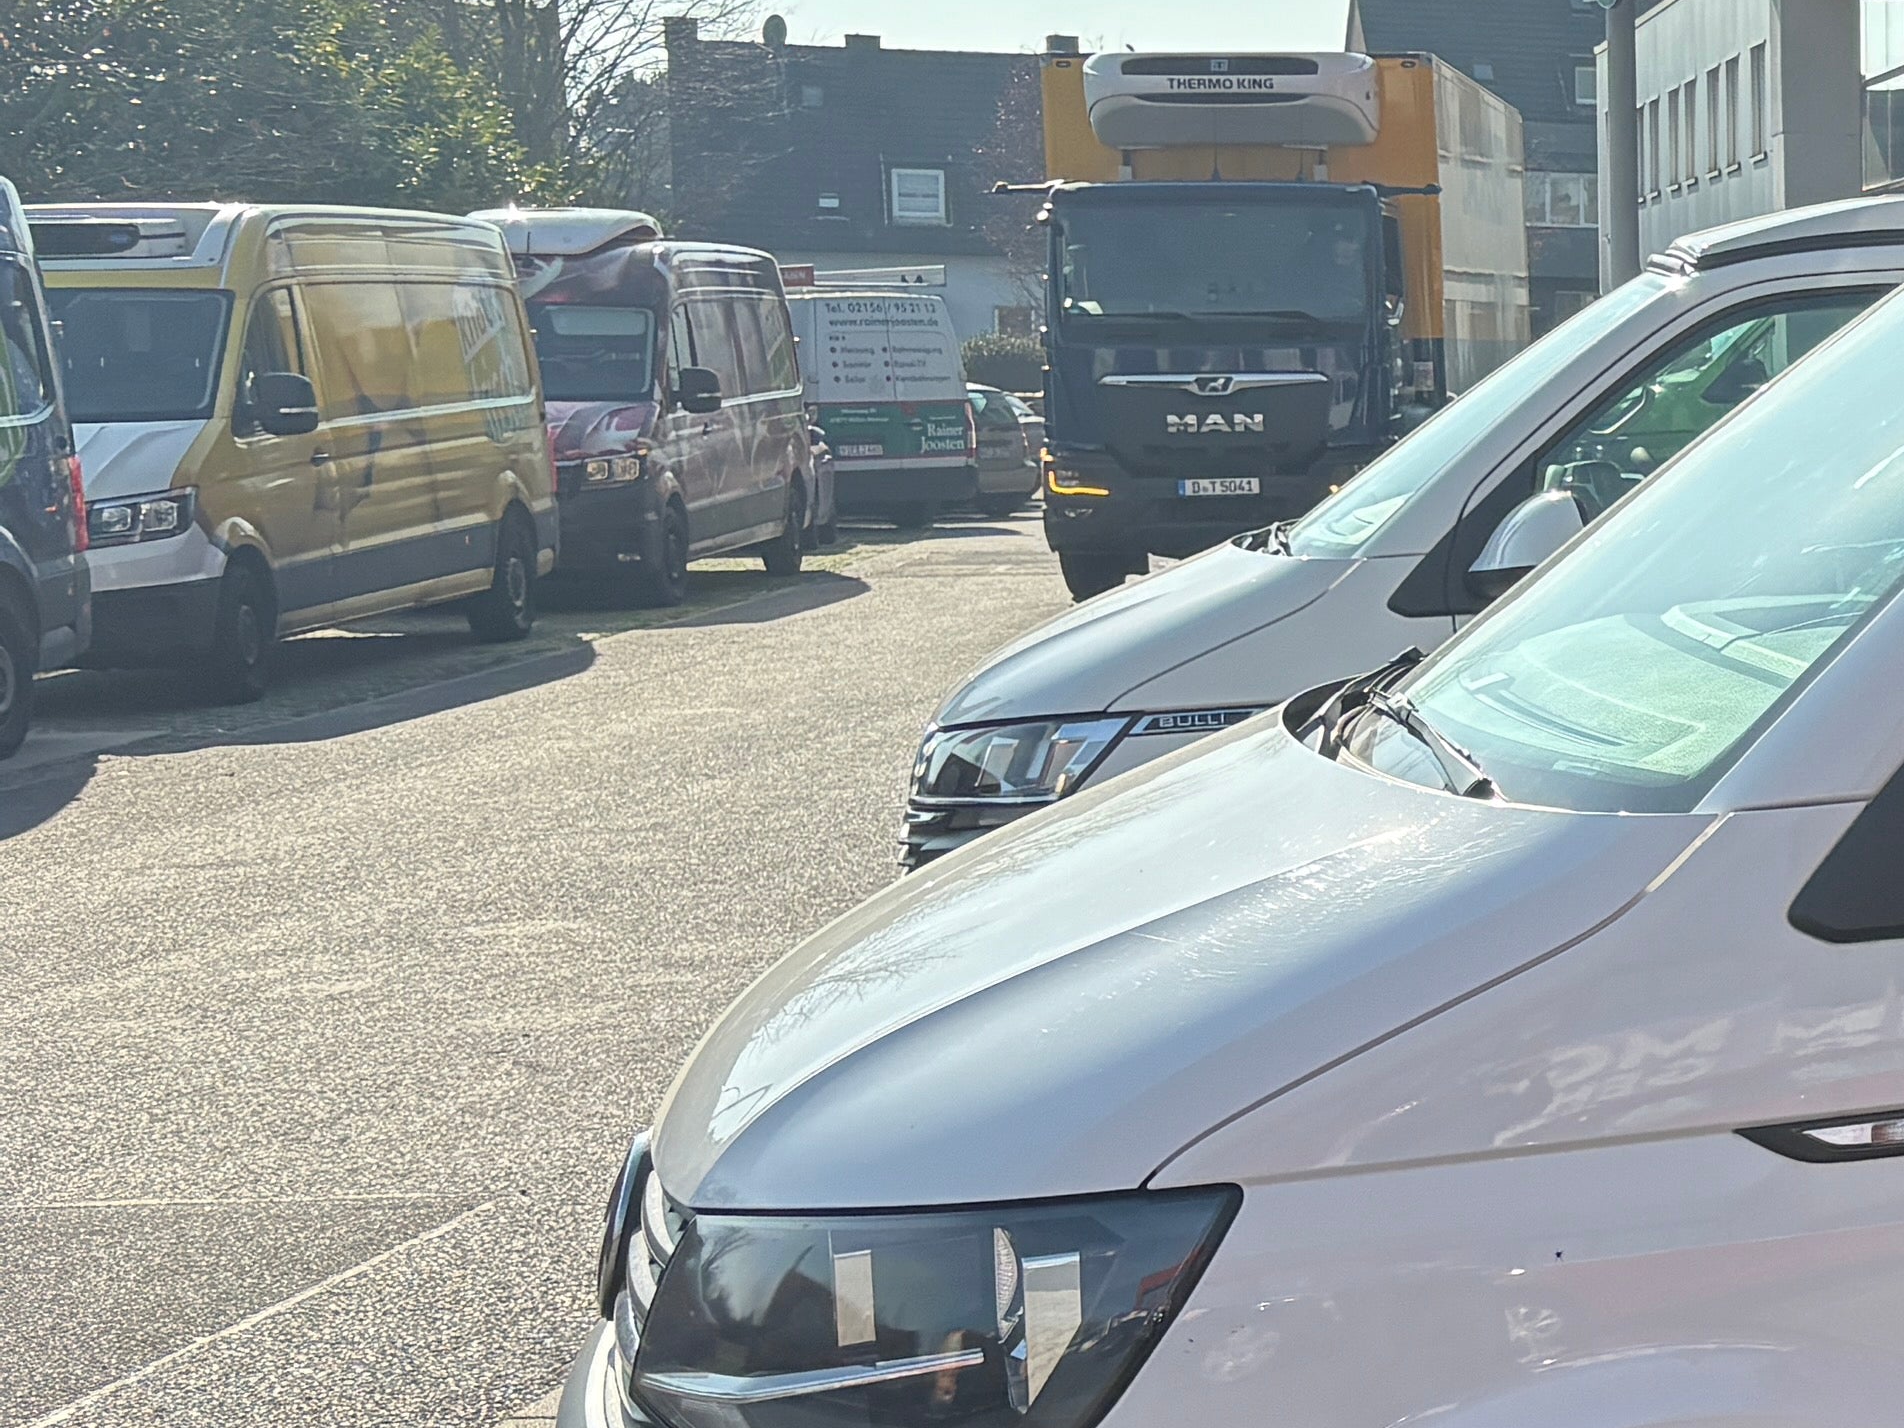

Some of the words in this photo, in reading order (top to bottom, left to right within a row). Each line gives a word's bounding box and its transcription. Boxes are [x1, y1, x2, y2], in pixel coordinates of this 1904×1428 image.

[1167, 77, 1233, 90] THERMO
[1236, 77, 1274, 90] KING
[825, 302, 844, 313] Tel.
[847, 302, 883, 313] 02156
[927, 423, 963, 437] Rainer
[1166, 413, 1264, 433] MAN
[920, 436, 965, 454] Joosten
[1159, 713, 1225, 728] BULLI
